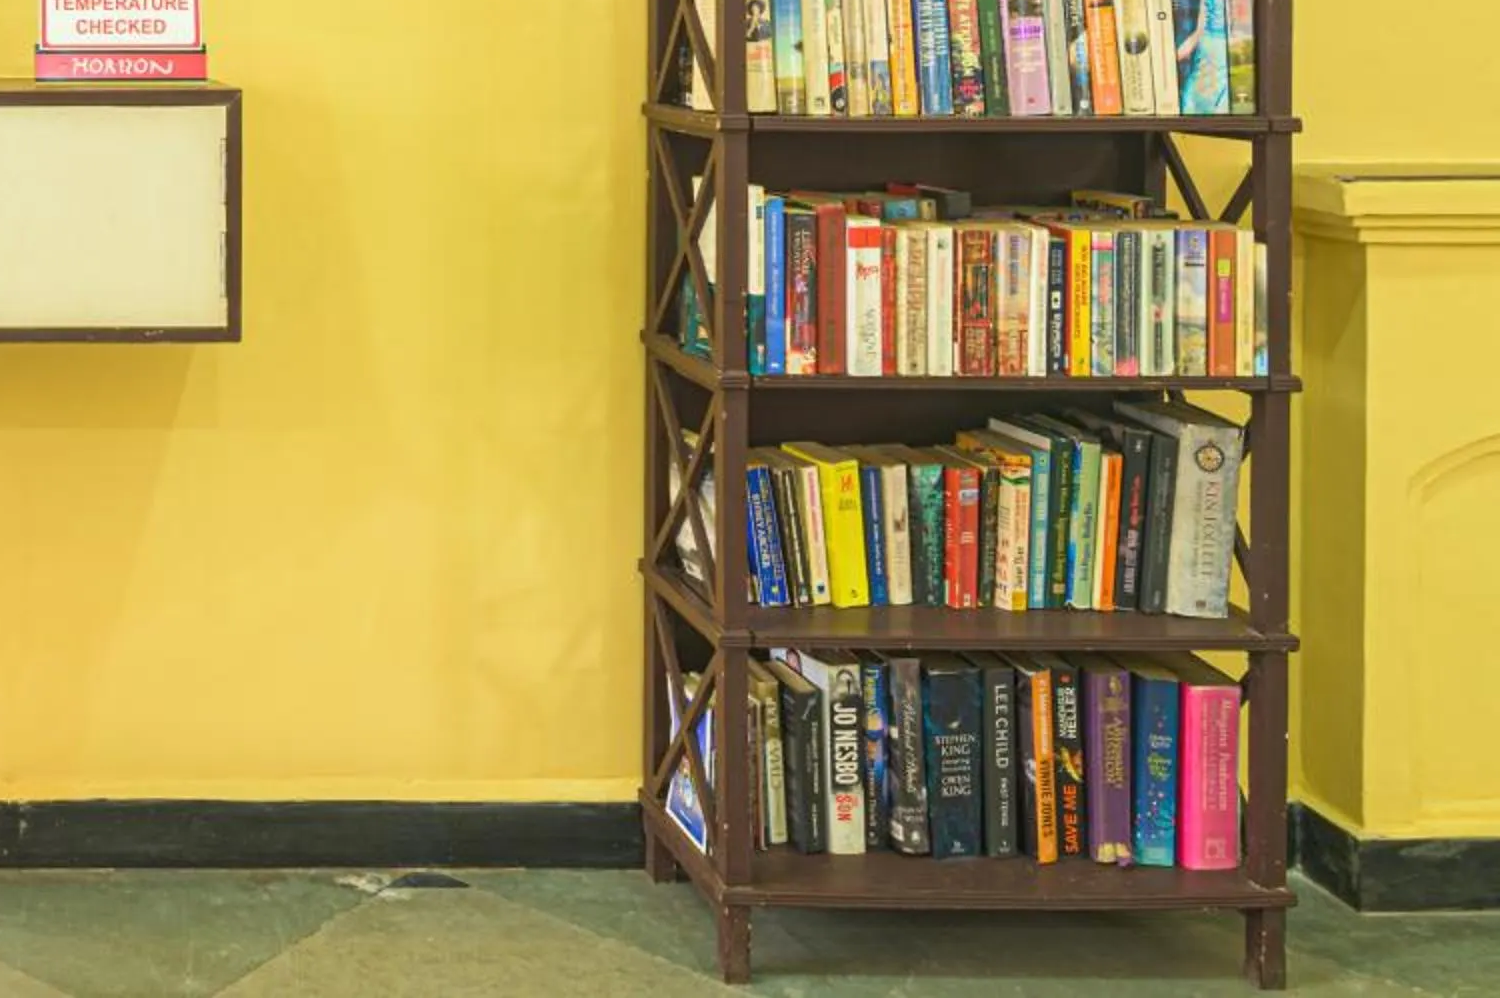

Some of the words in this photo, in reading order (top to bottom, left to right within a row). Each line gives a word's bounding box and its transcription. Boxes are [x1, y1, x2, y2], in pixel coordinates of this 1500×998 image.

[76, 18, 167, 35] CHECKED
[833, 703, 857, 725] JO
[994, 684, 1009, 715] LEE
[1065, 687, 1078, 739] HELLER
[935, 733, 975, 745] STEPHEN
[941, 745, 971, 756] KING
[995, 717, 1010, 769] CHILD
[833, 729, 859, 785] NESBO
[941, 785, 972, 797] KING
[1039, 760, 1053, 799] VINNIE
[836, 794, 853, 822] SON
[1063, 785, 1077, 810] ME
[1042, 801, 1055, 838] JONES
[1063, 814, 1080, 854] SAVE
